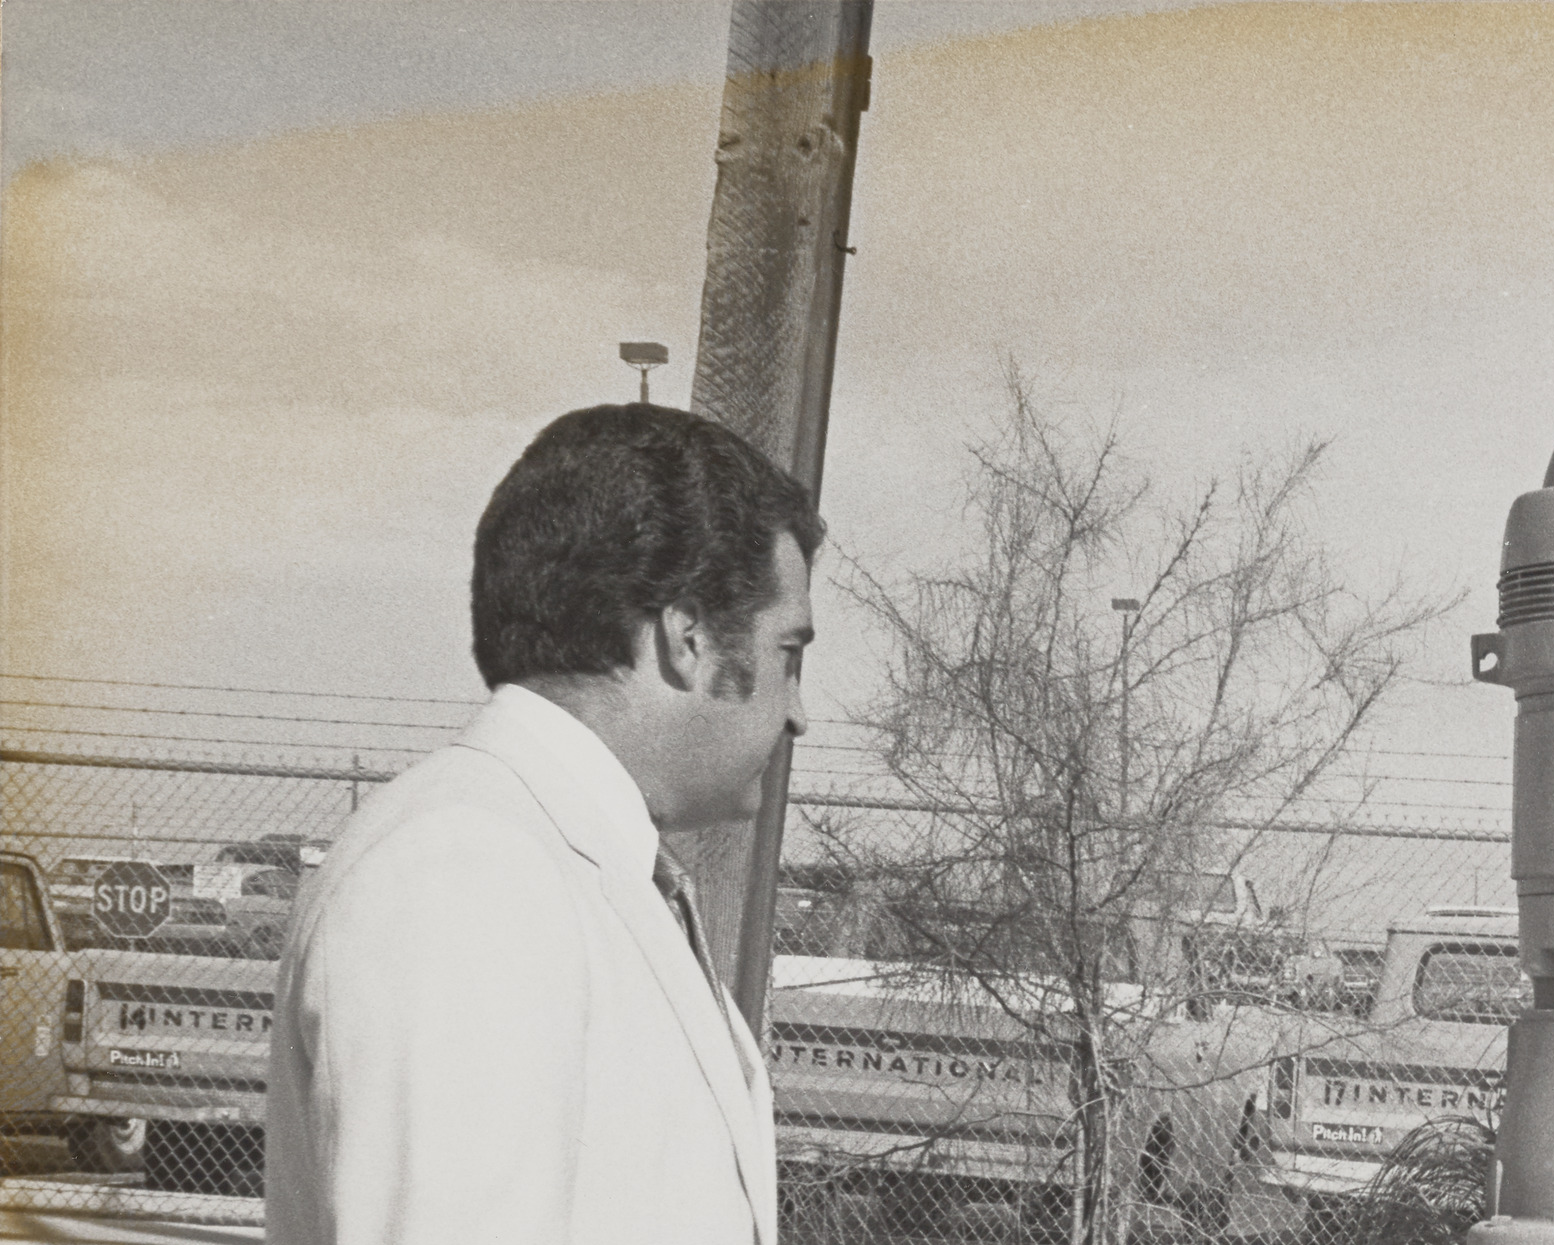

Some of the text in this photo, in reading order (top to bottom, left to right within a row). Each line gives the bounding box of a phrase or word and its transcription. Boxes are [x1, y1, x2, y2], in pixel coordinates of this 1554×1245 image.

[97, 885, 167, 913] STOP
[1324, 1080, 1344, 1106] 17
[1313, 1125, 1347, 1142] Pitch
